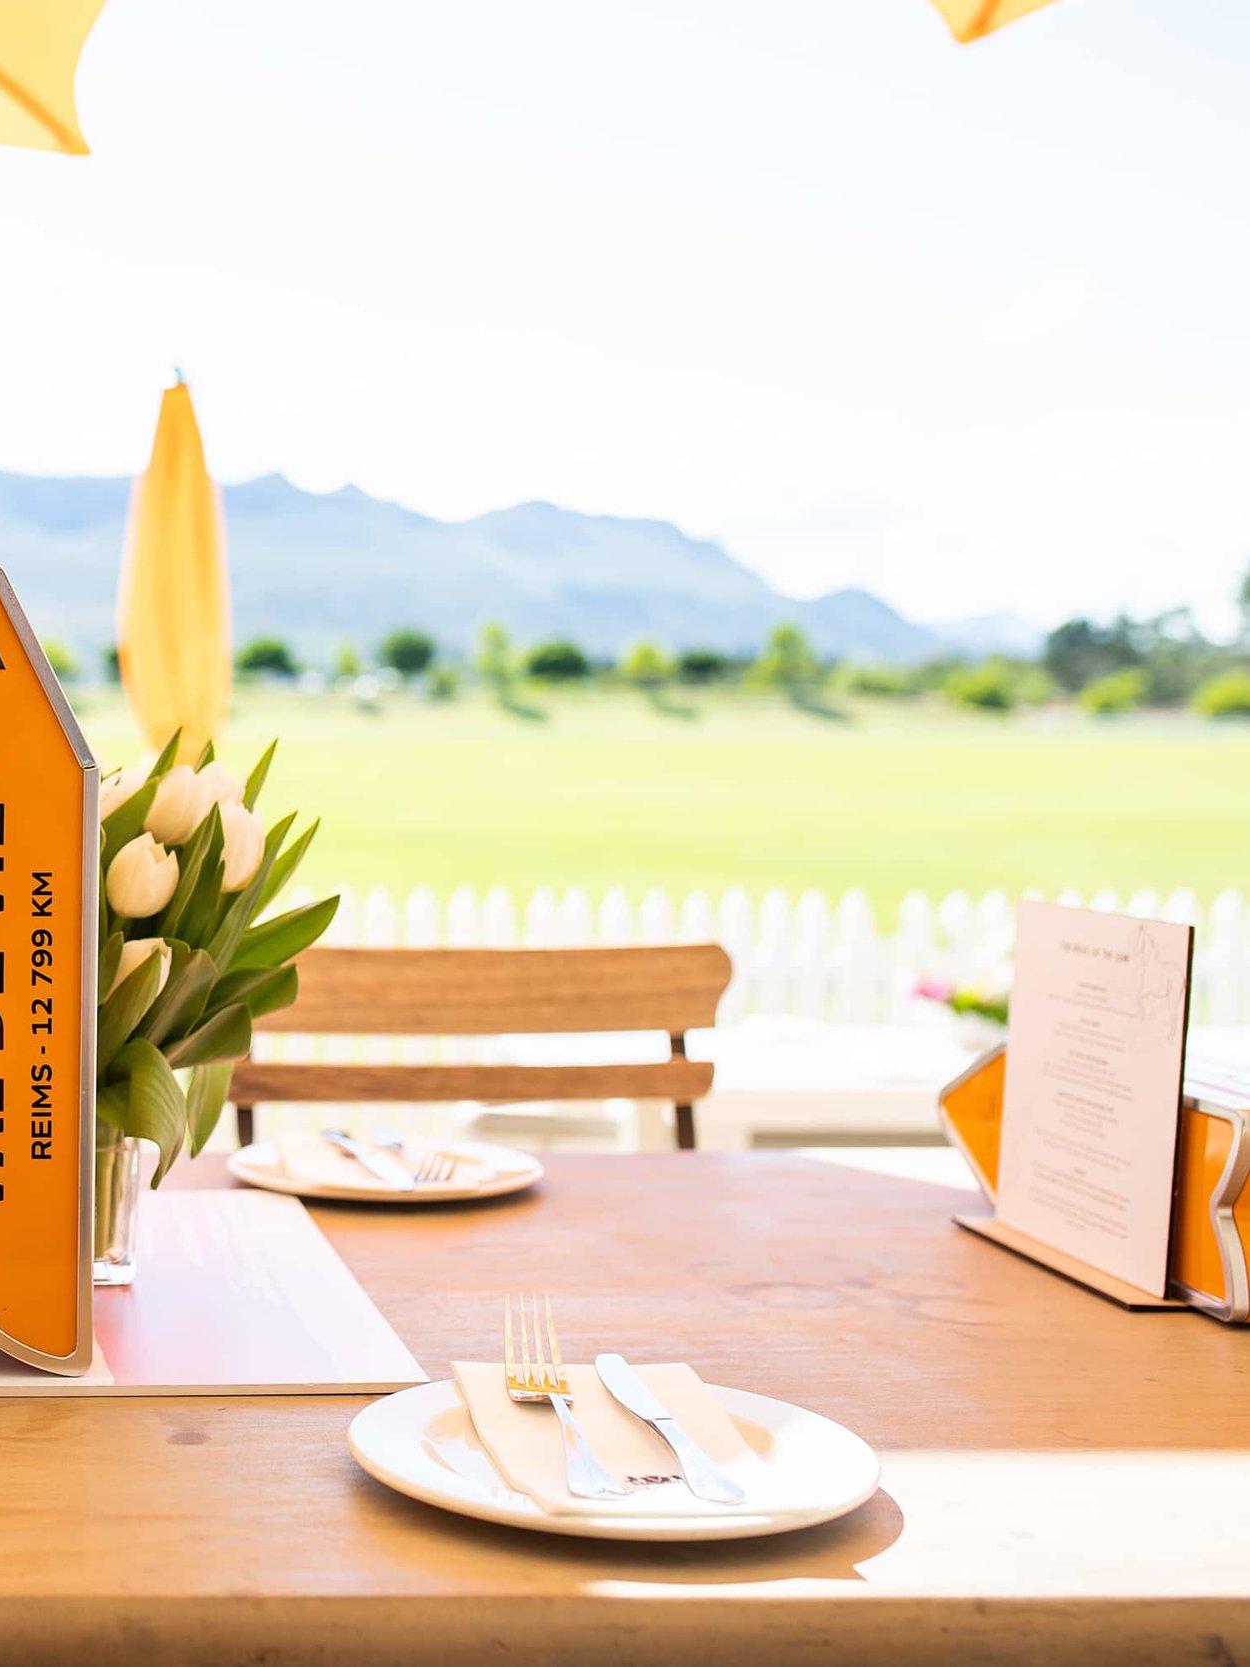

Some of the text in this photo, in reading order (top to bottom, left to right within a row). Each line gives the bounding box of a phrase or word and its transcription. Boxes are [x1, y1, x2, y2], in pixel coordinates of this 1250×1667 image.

[31, 872, 53, 917] KM
[31, 928, 53, 987] 799
[31, 997, 53, 1035] 12
[31, 1063, 53, 1160] REIMS
